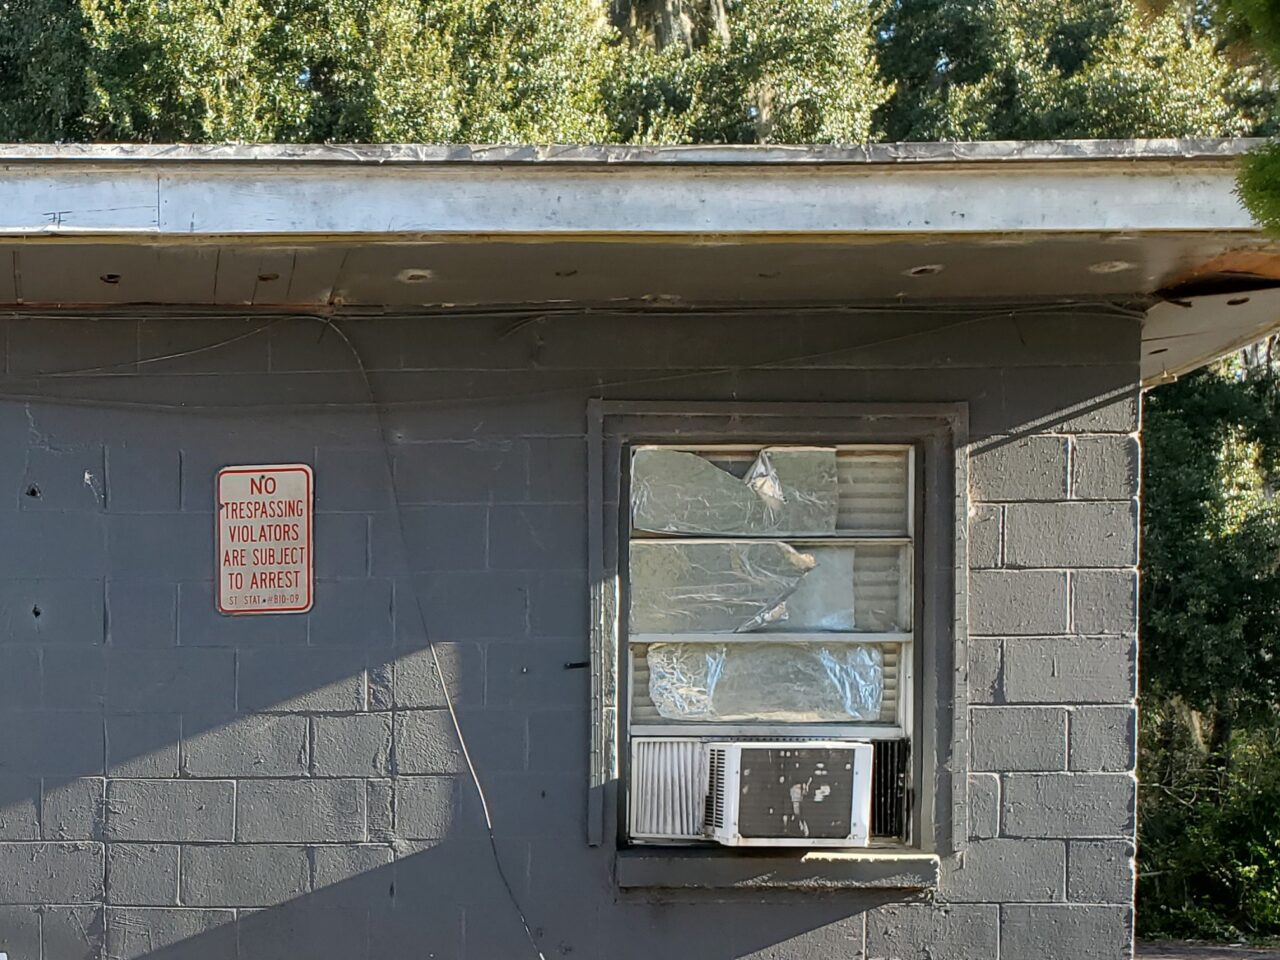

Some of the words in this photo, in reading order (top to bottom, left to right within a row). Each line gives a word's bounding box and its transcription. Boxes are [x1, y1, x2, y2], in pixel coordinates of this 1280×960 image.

[250, 477, 276, 495] NO
[224, 500, 303, 519] TRESPASSING
[228, 524, 299, 543] VIOLATORS
[224, 549, 246, 567] ARE
[252, 546, 305, 565] SUBJECT
[228, 572, 242, 590] TO
[250, 570, 300, 589] ARREST
